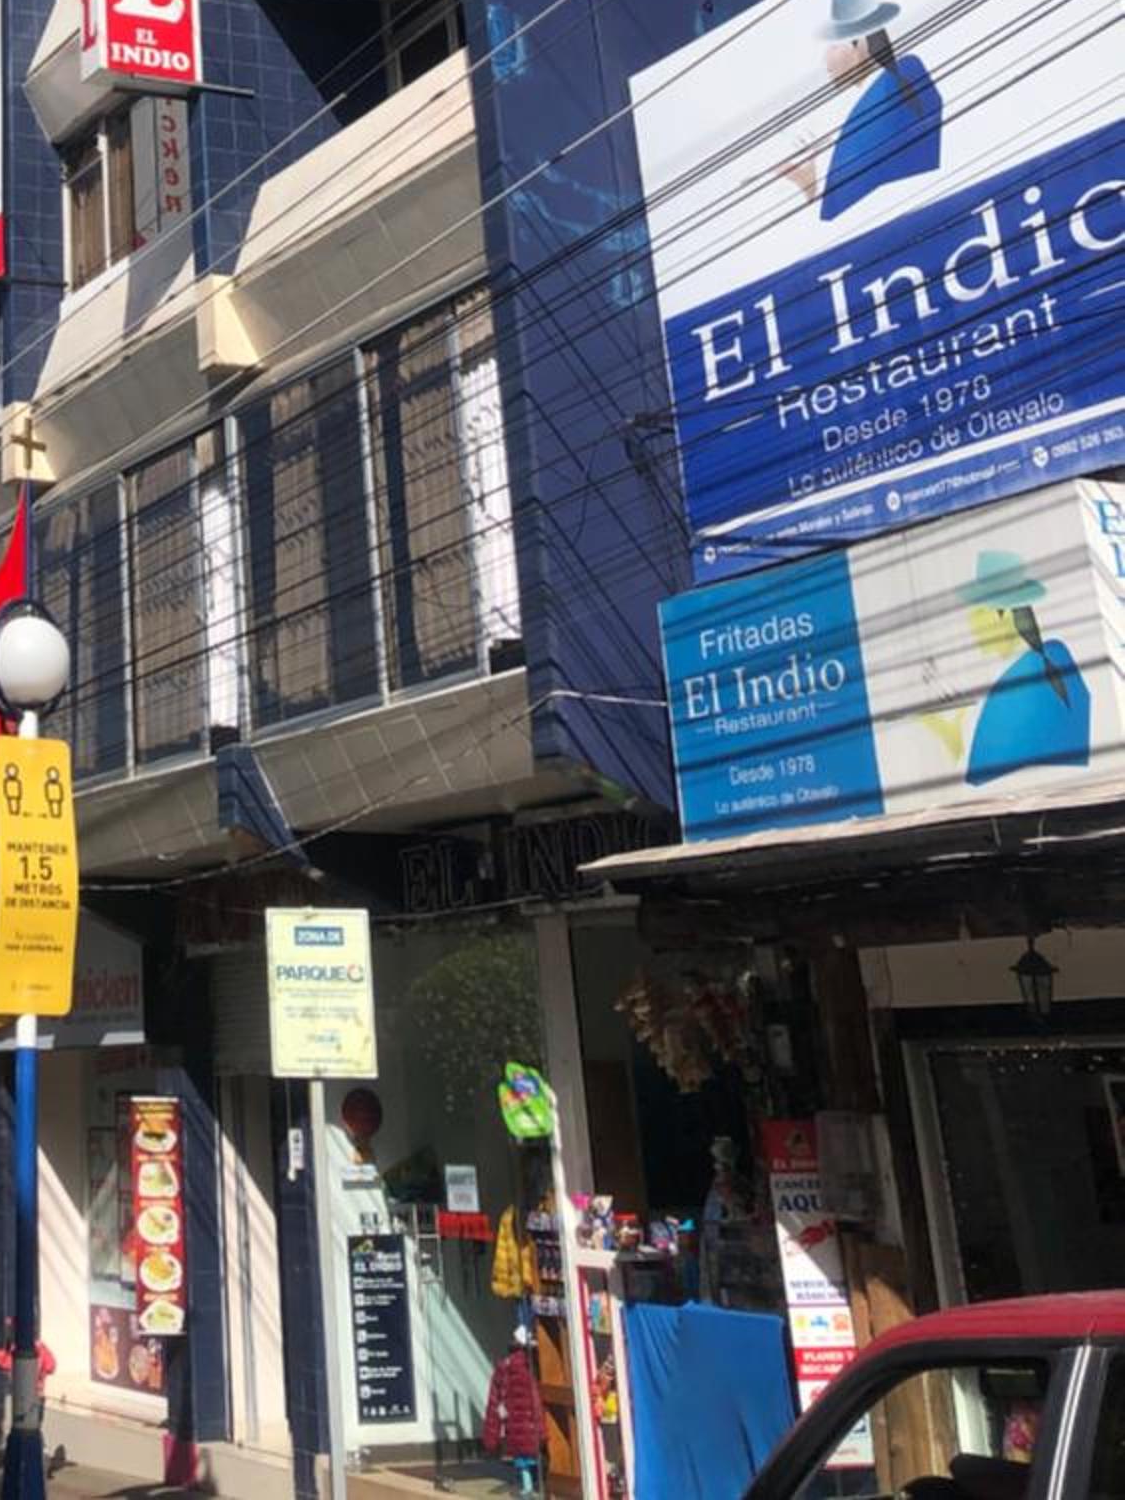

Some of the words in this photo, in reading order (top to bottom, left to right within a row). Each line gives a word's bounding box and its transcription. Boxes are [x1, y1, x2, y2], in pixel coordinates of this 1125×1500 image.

[136, 26, 159, 46] EL
[110, 41, 191, 71] INDIO
[691, 294, 792, 402] El
[777, 292, 1063, 428] Restaurant
[822, 405, 908, 453] Desde
[923, 373, 992, 418] 1978
[931, 424, 961, 451] de
[968, 389, 1065, 438] Otavalo
[699, 612, 815, 660] Fritadas
[683, 674, 719, 720] El
[731, 652, 846, 709] Indio
[714, 701, 817, 736] Restaurant
[729, 764, 775, 787] Desde
[779, 753, 816, 776] 1978
[6, 841, 68, 854] MANTENER
[19, 855, 53, 880] 1.5
[13, 883, 63, 895] METROS
[276, 964, 364, 983] PARQUEO
